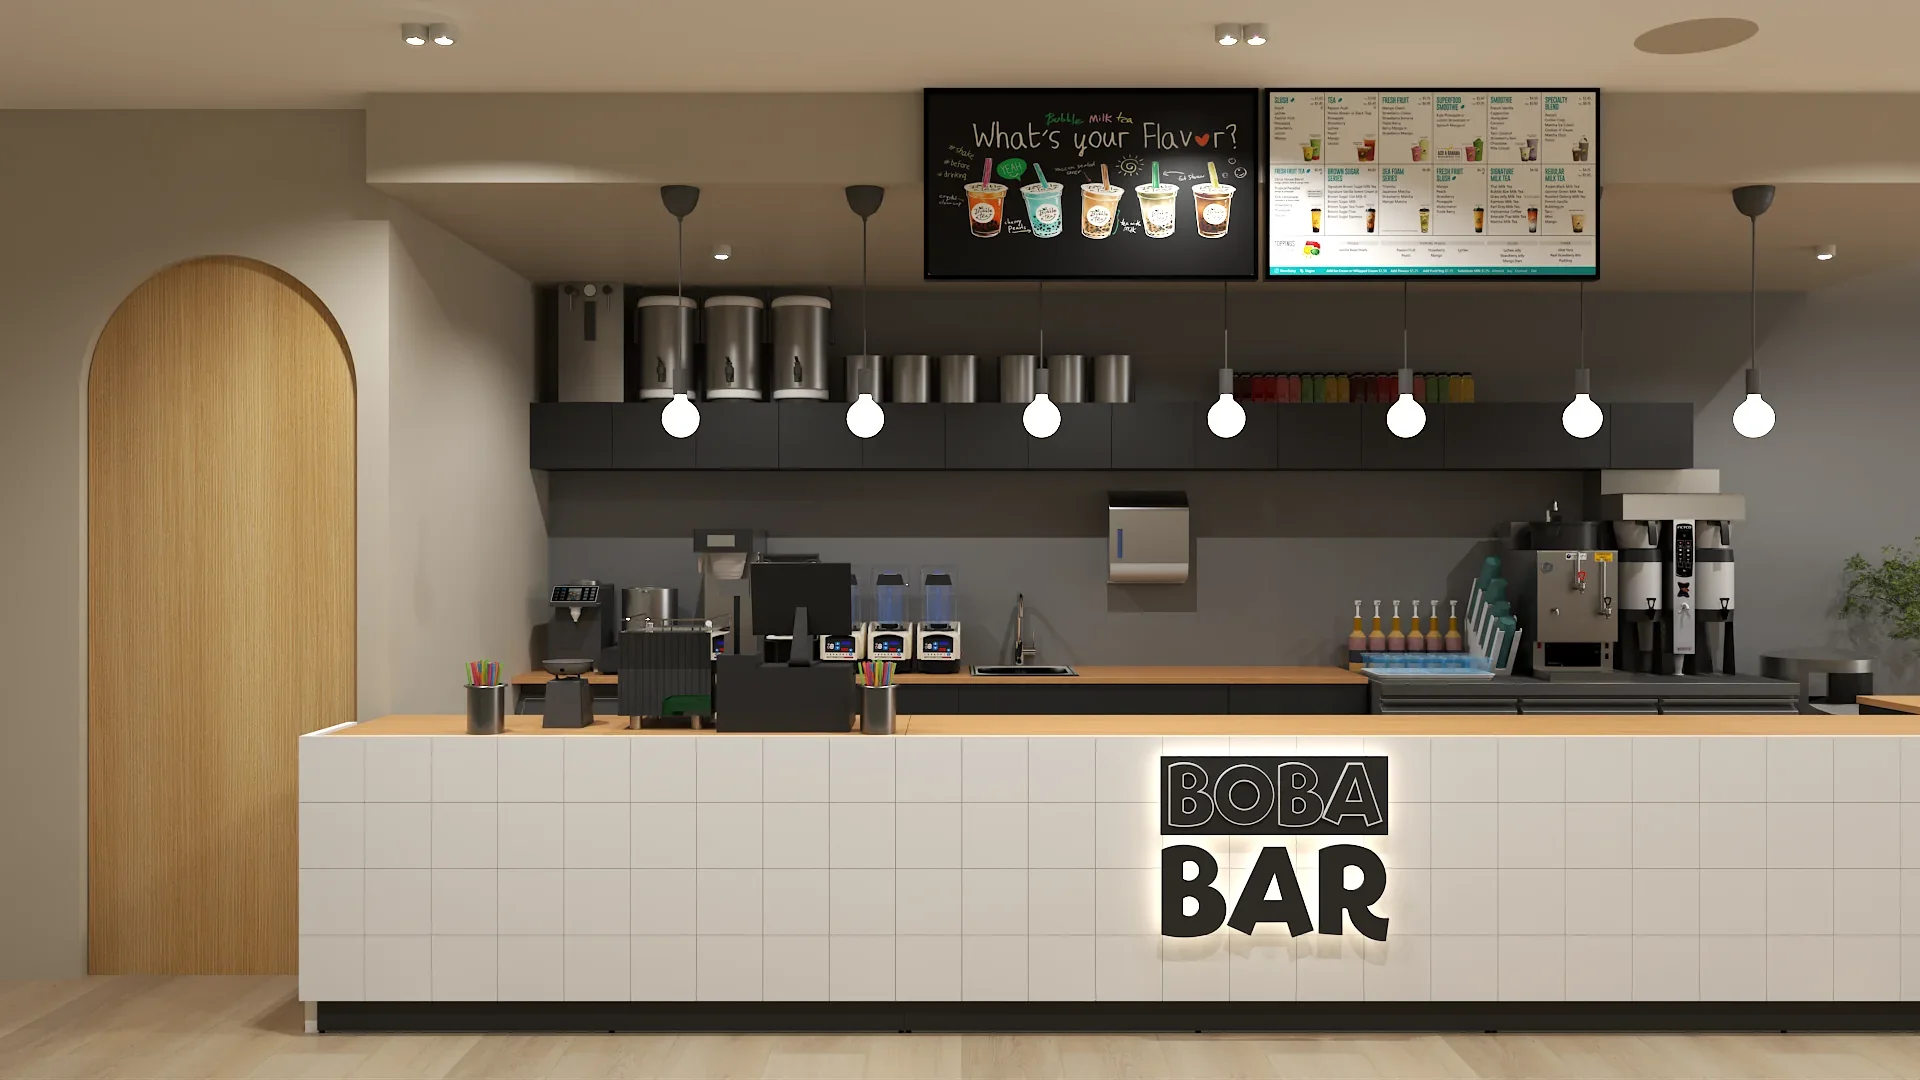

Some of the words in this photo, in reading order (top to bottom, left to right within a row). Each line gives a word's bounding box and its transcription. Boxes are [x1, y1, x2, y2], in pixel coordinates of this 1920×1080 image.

[1046, 112, 1084, 125] Bubble
[1117, 112, 1133, 124] tea
[973, 121, 1060, 150] What's
[1074, 131, 1130, 156] your
[1000, 160, 1023, 175] YEAH
[1168, 762, 1382, 827] BOBA
[1162, 844, 1389, 941] BAR
